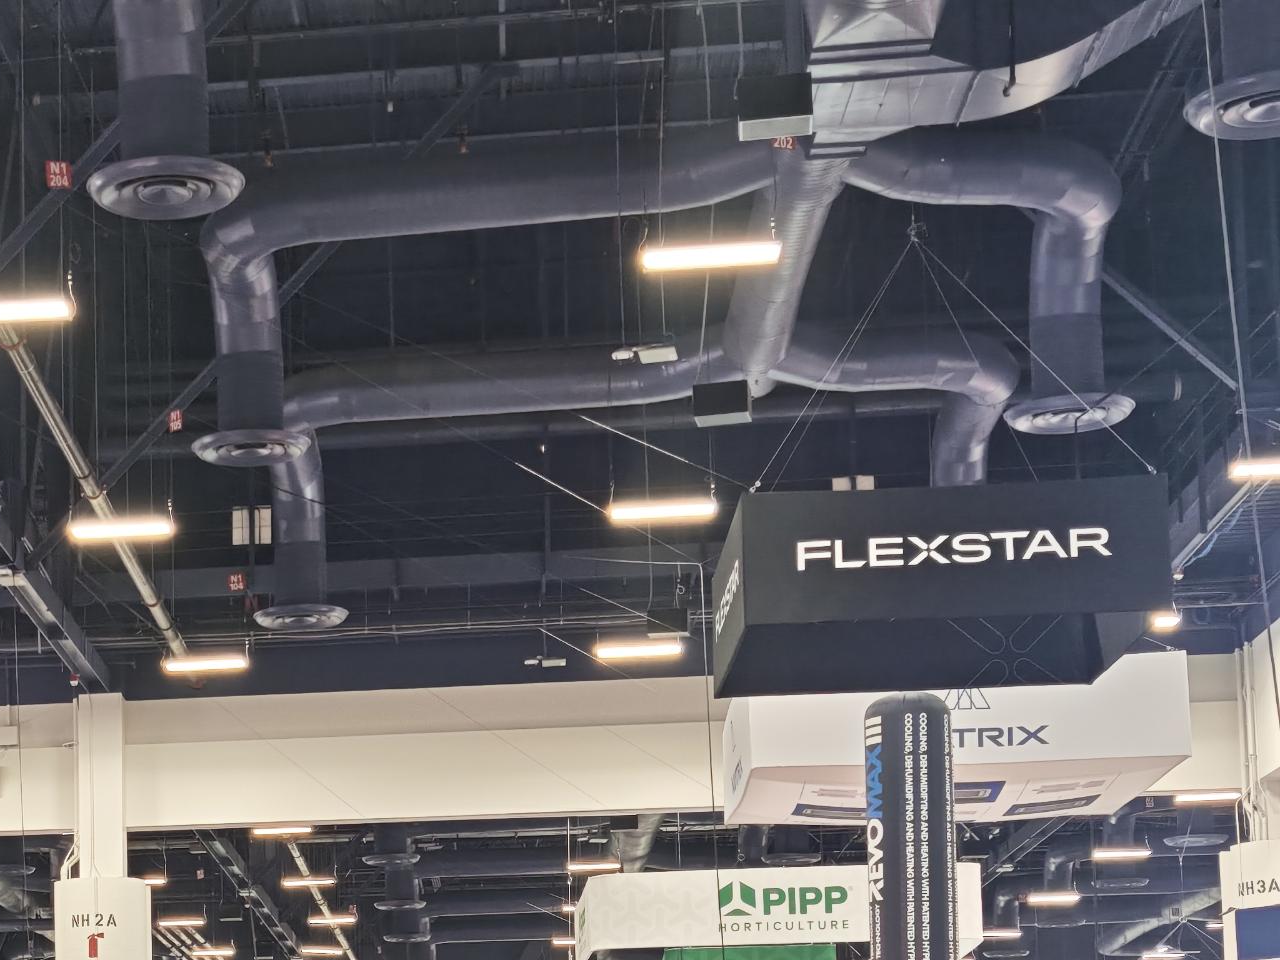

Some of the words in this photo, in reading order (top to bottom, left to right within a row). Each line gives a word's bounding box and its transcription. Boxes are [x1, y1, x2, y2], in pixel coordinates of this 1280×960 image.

[49, 161, 67, 174] N1
[796, 526, 1114, 573] FLEXSTAR
[953, 725, 1051, 749] TRIX
[906, 822, 914, 841] AND
[920, 822, 928, 841] AND
[906, 842, 914, 878] HEATING
[921, 841, 929, 878] HEATING
[762, 885, 849, 916] PIPP
[906, 879, 915, 901] WITH
[921, 879, 929, 900] WITH
[717, 919, 850, 933] HORTICULTURE
[907, 902, 915, 940] PATENTED
[922, 902, 930, 940] PATENTED
